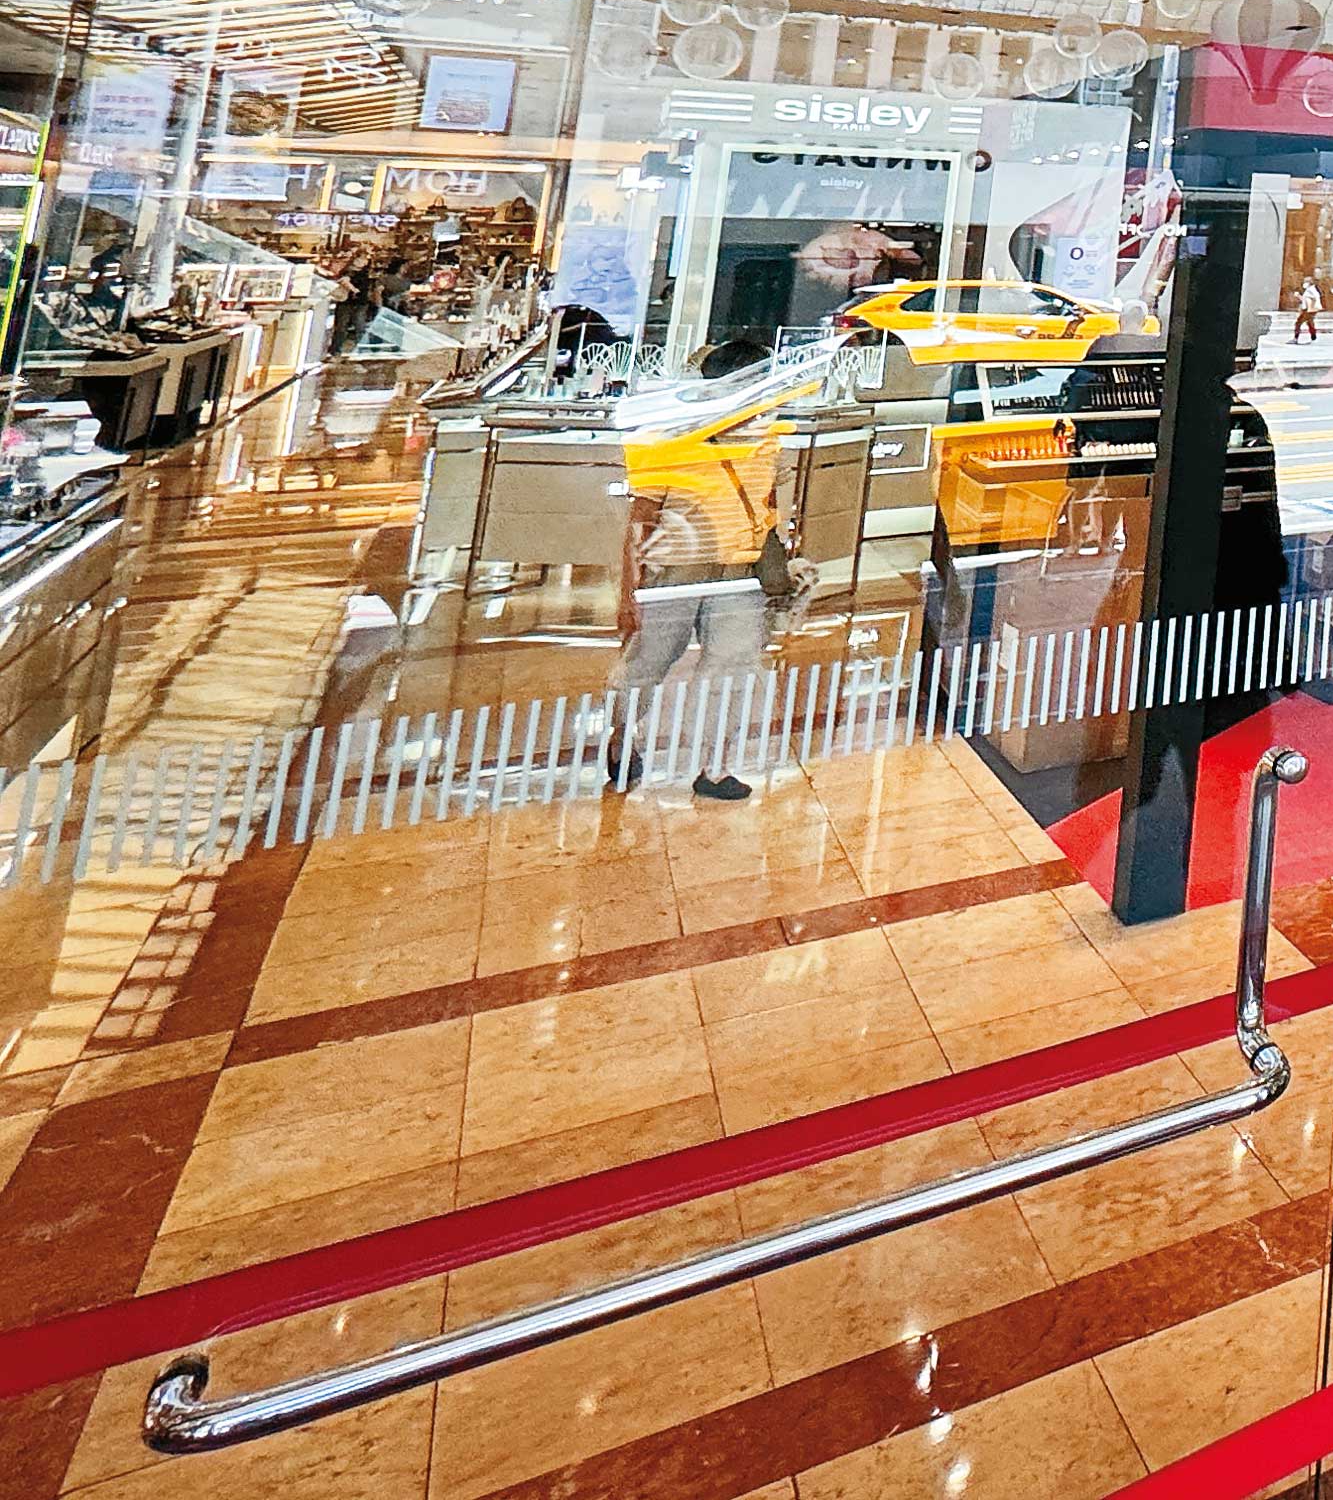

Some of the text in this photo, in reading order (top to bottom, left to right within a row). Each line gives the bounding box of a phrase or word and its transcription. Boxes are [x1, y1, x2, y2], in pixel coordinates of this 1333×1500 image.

[774, 94, 932, 134] sisley
[833, 123, 871, 132] PARIS
[820, 177, 863, 191] sisley
